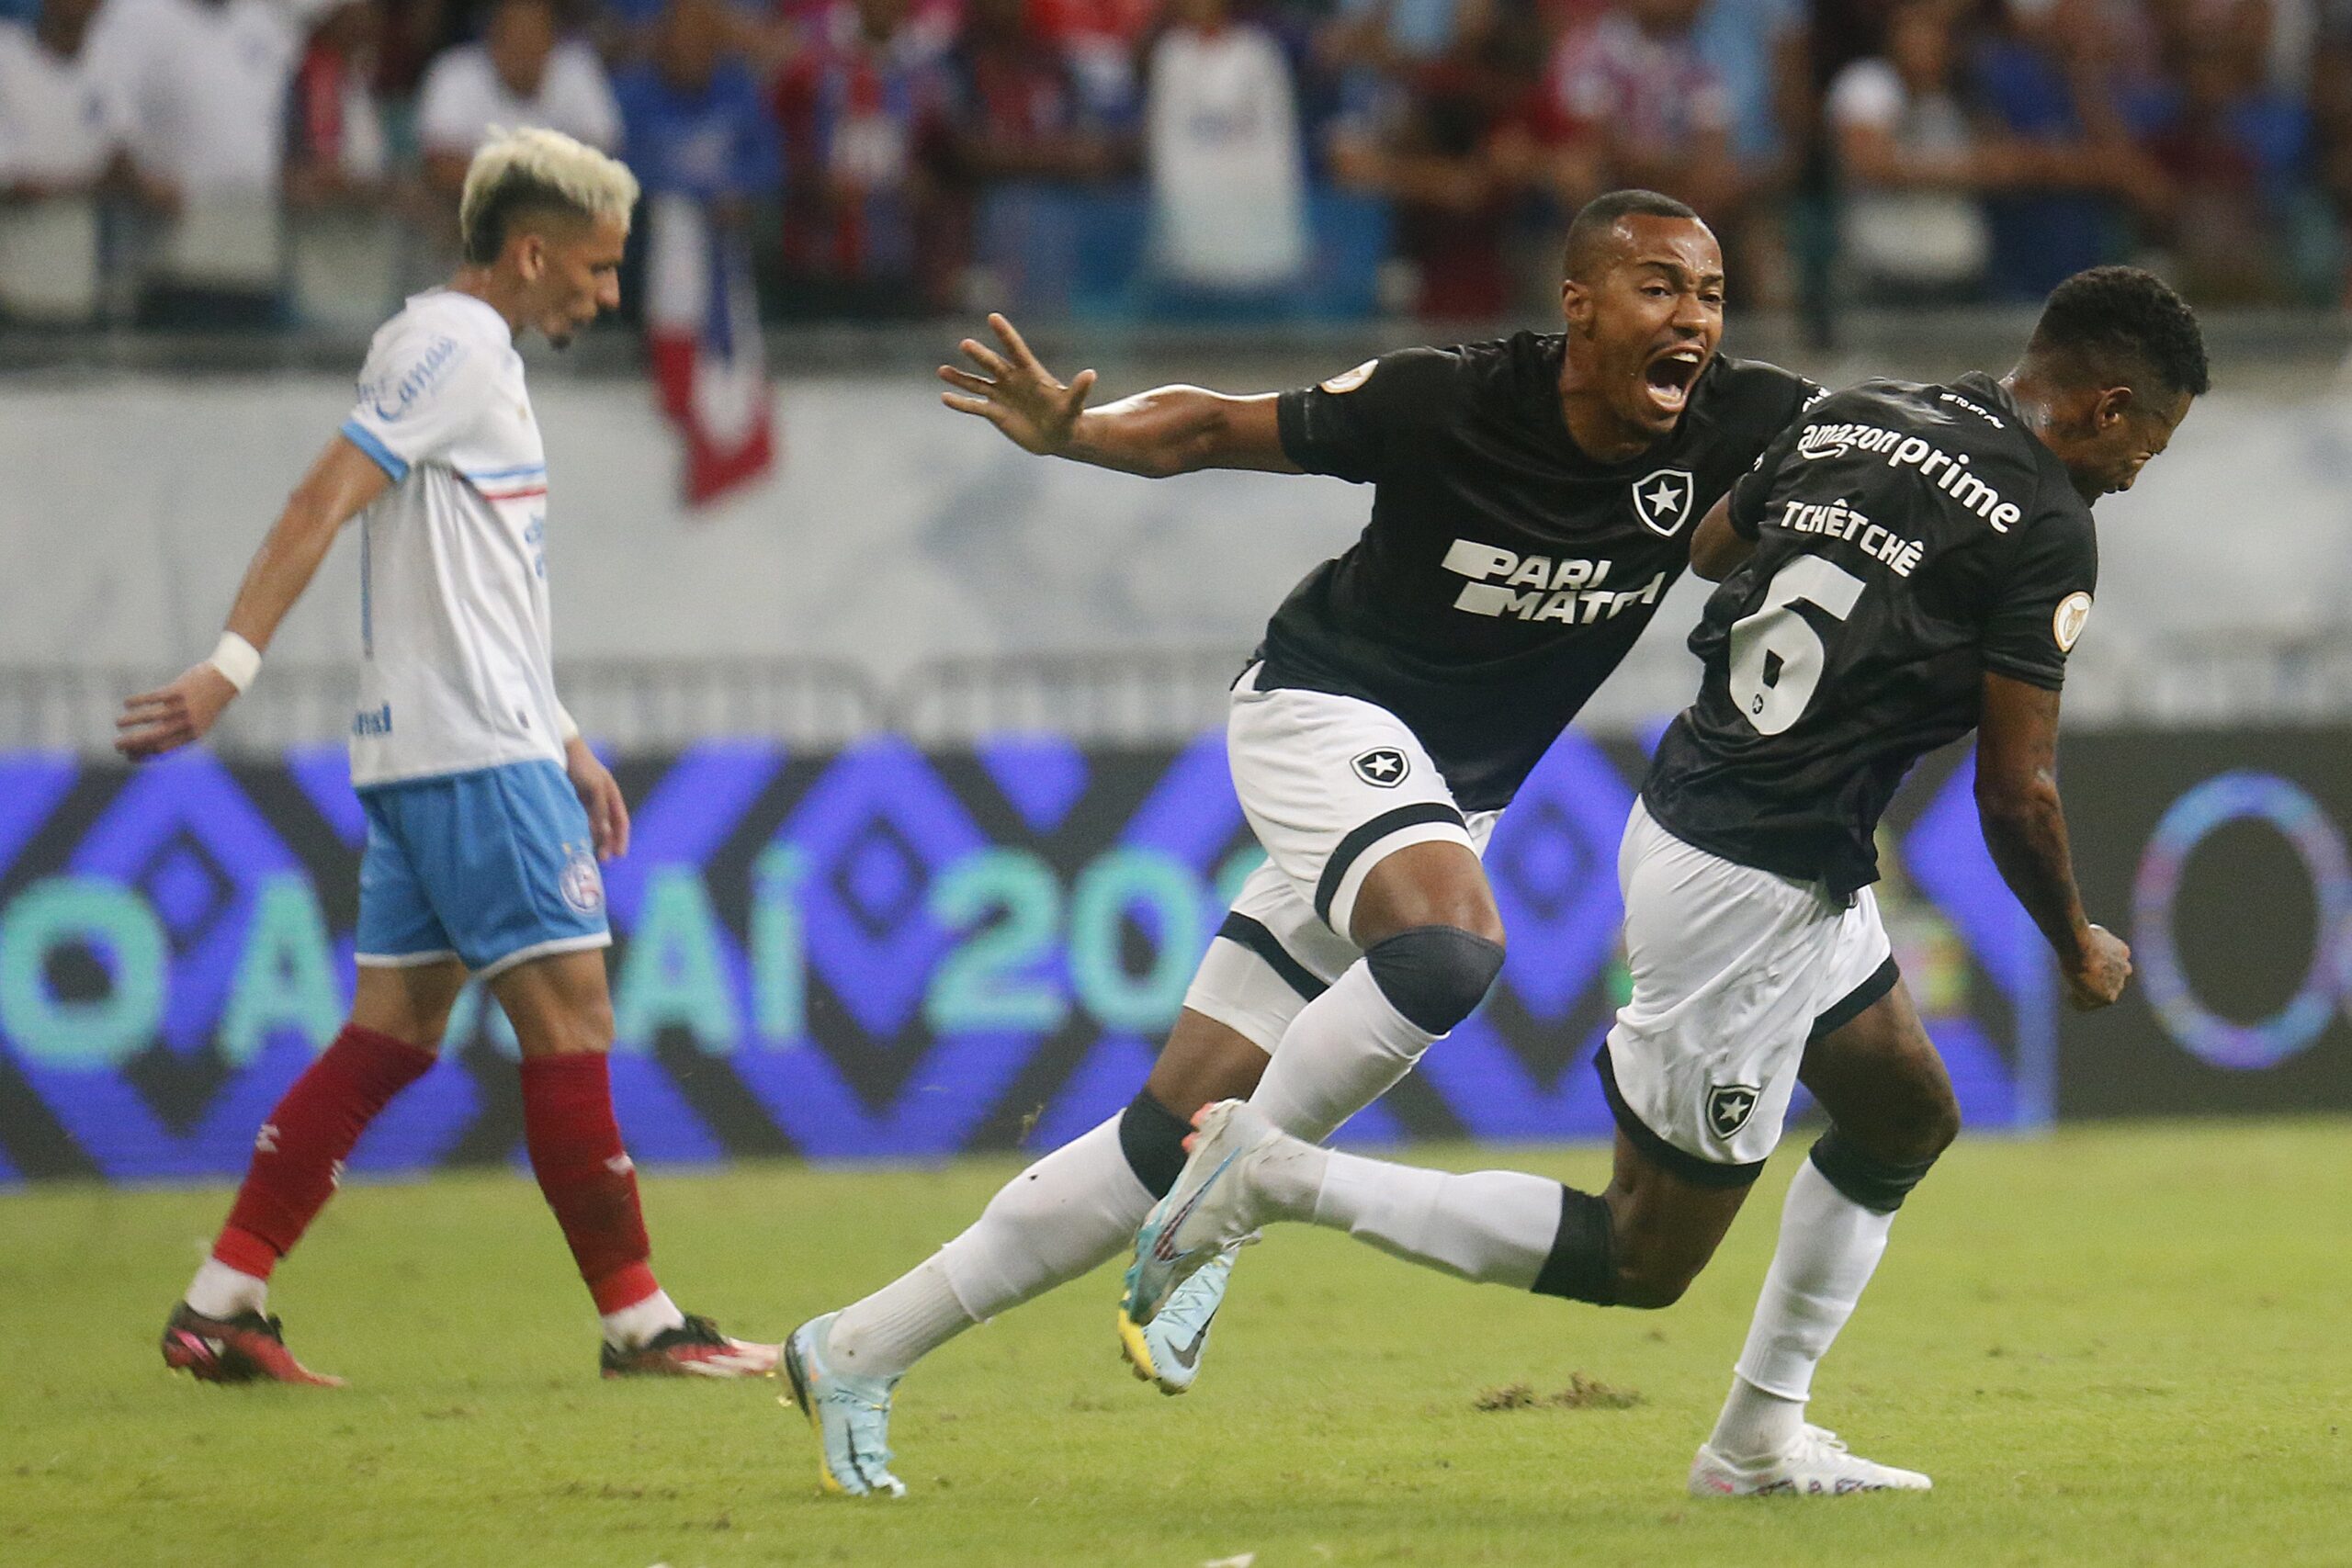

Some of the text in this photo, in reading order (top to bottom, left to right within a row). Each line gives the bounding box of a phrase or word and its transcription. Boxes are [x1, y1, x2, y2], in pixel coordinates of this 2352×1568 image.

[1797, 423, 2020, 534] amazon prime
[1441, 538, 1612, 591] PARI
[1781, 498, 1924, 577] TCHÊTCHÊ
[1729, 554, 1867, 736] 6
[923, 843, 1266, 1038] 20
